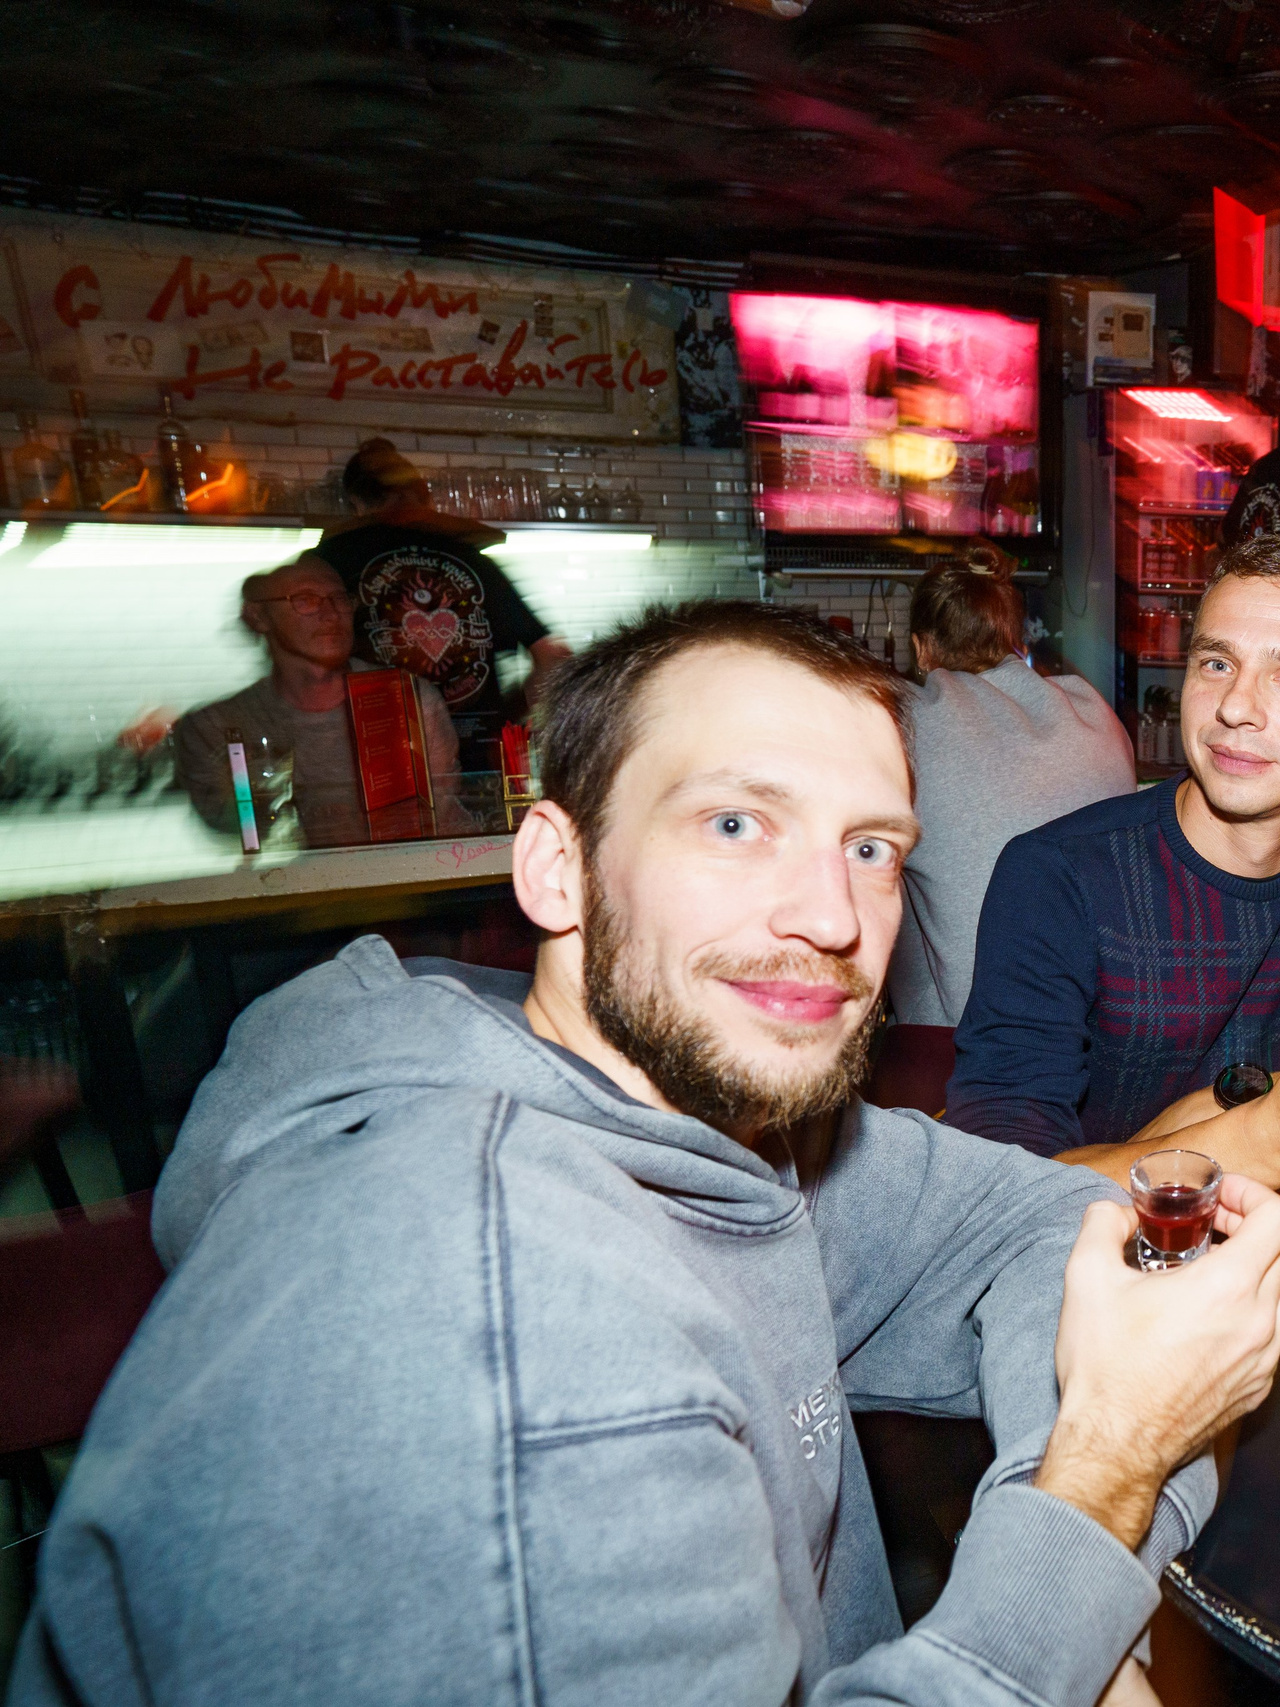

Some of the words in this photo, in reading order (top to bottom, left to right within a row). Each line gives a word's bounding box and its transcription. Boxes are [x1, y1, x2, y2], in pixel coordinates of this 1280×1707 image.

[54, 264, 101, 328] С
[171, 344, 294, 399] Не
[328, 320, 668, 401] Расставайтесь
